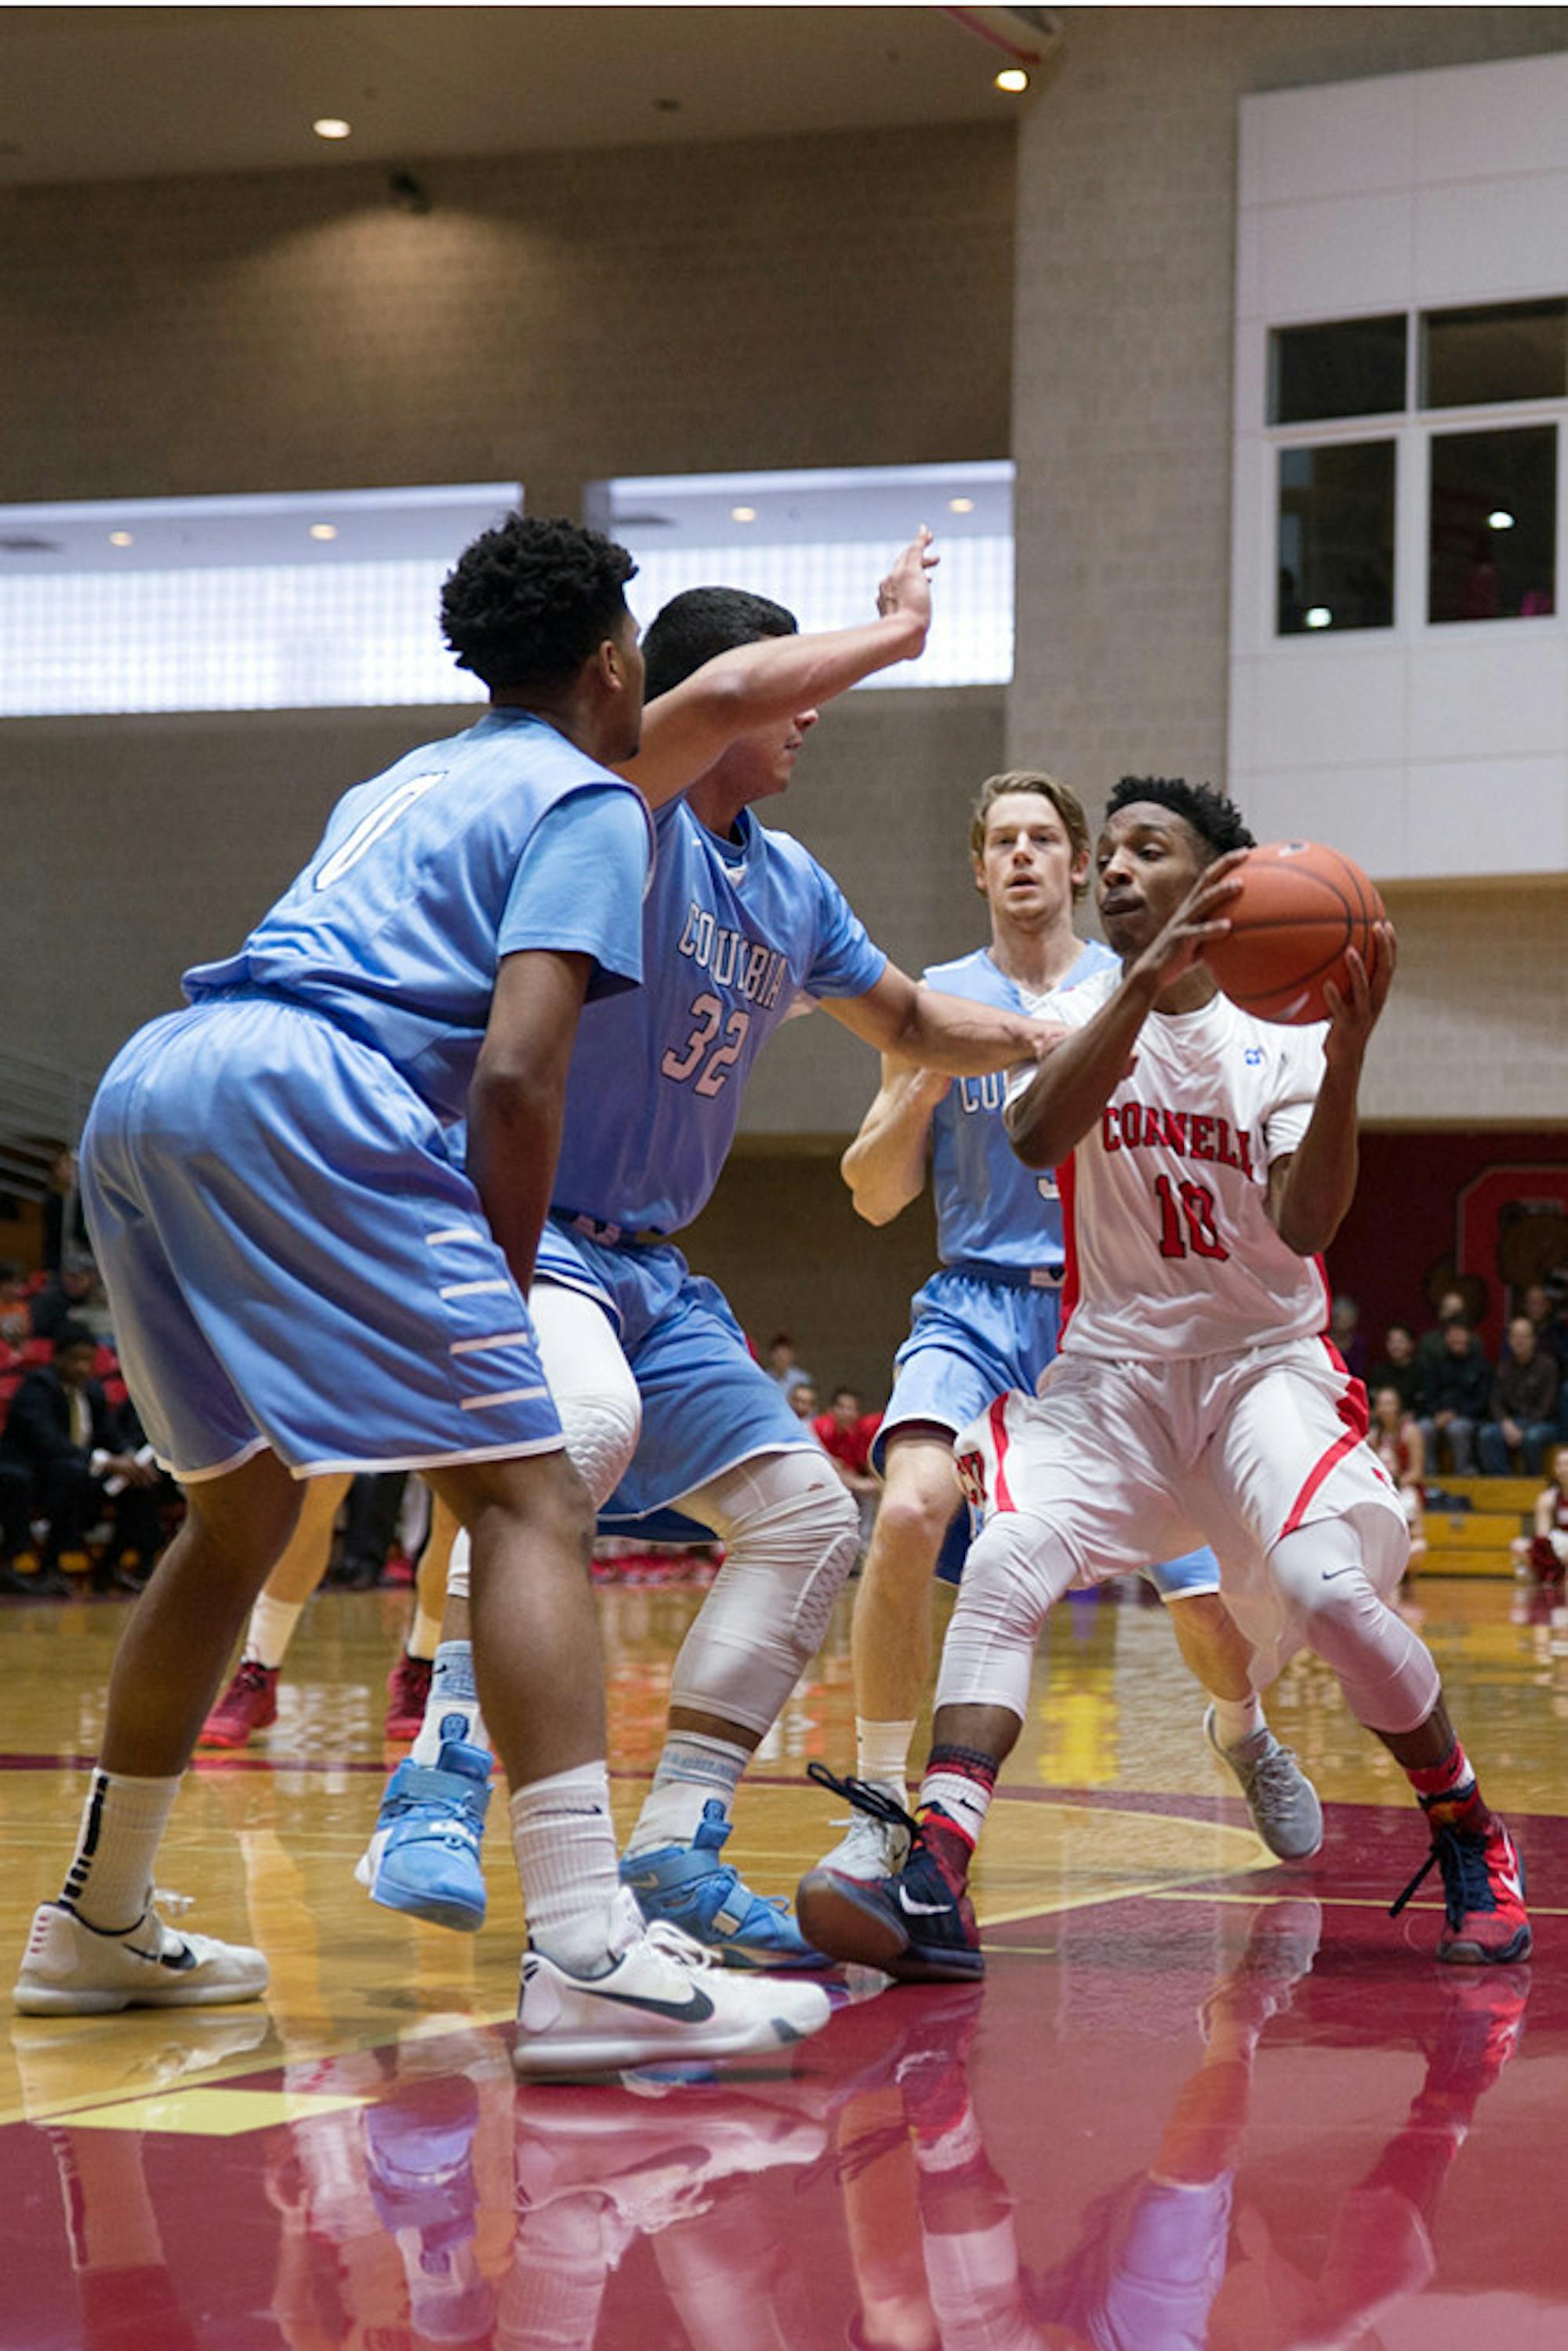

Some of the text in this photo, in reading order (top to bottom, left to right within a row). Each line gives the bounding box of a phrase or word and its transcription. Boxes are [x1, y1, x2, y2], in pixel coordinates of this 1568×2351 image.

[662, 992, 750, 1097] 32
[1103, 1102, 1254, 1183] CORNELL
[1156, 1174, 1230, 1261] 10
